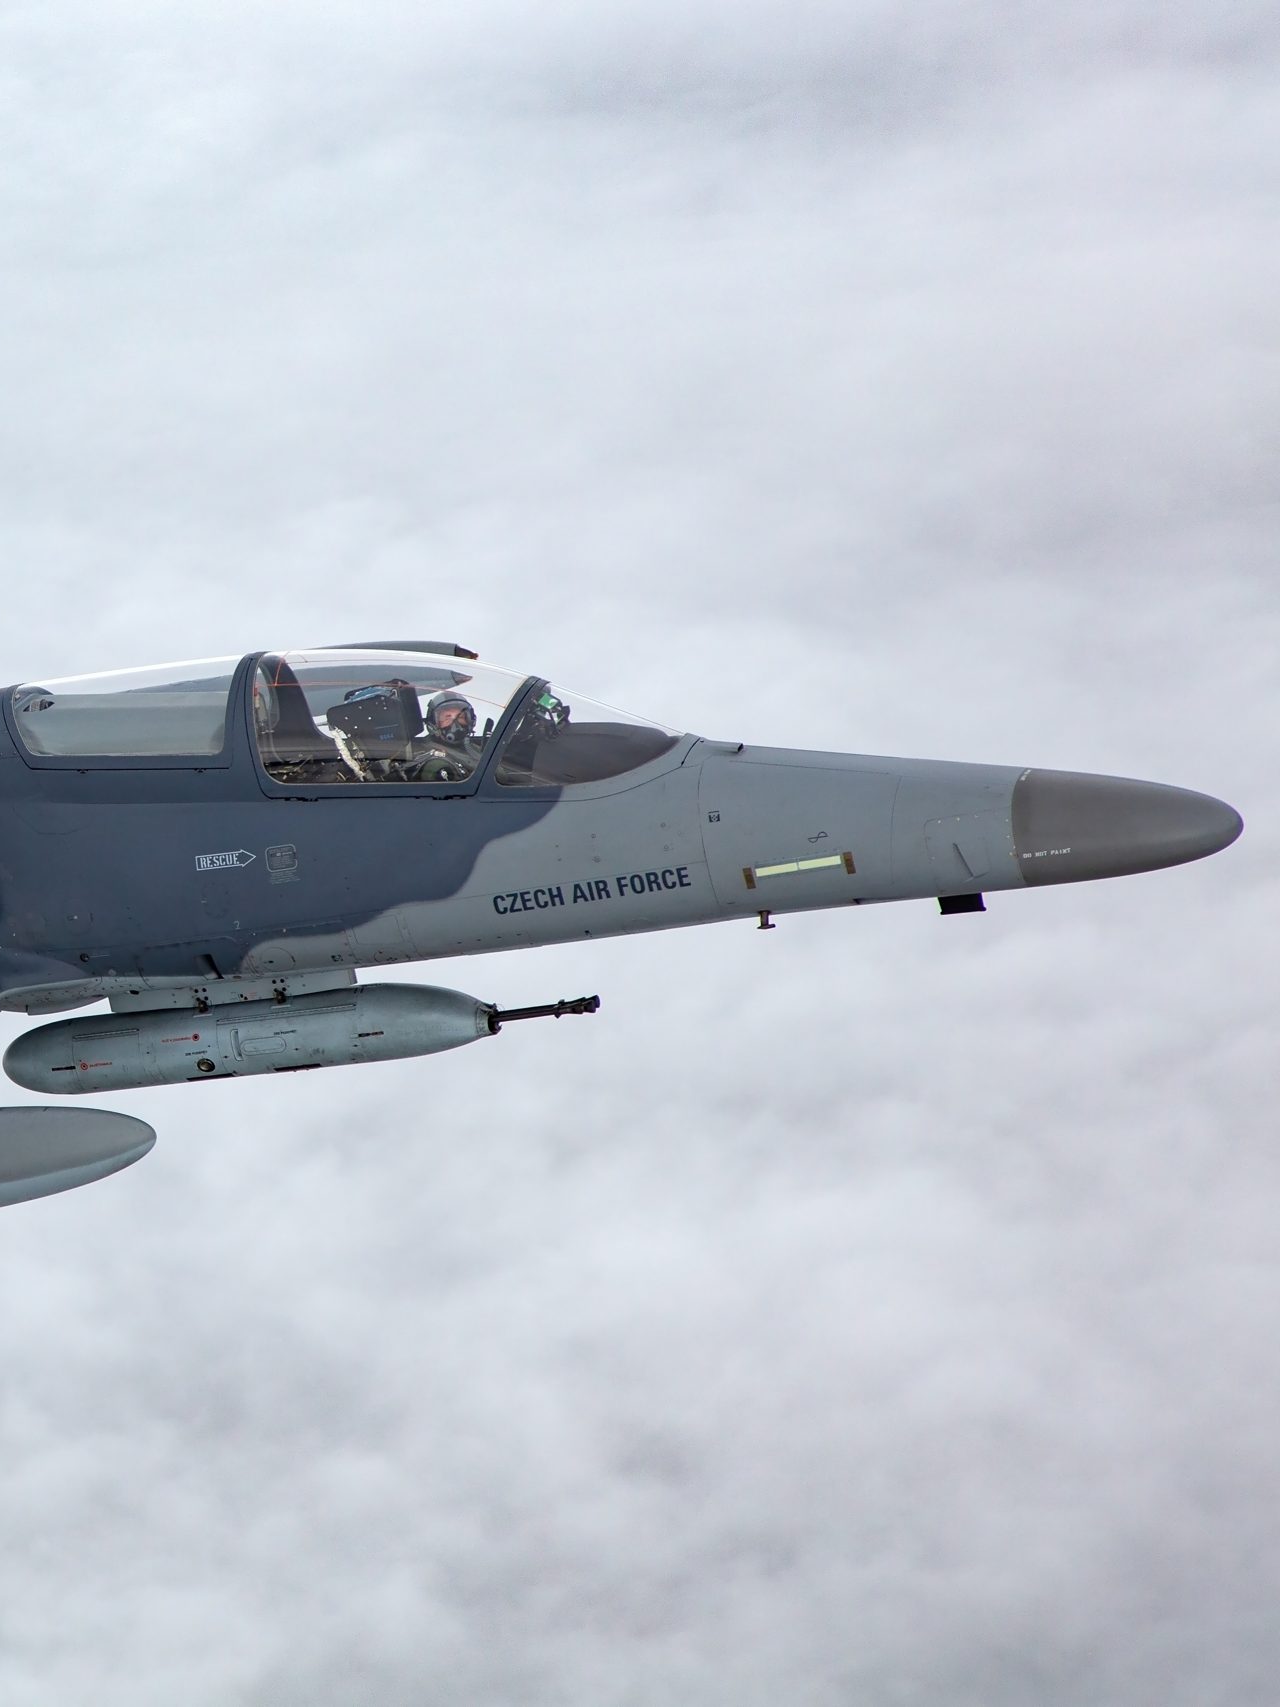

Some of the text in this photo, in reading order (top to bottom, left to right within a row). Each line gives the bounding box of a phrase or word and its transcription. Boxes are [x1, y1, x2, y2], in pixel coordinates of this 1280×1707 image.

[1050, 847, 1071, 856] PAINT
[200, 853, 240, 869] RESCUE
[492, 866, 692, 915] CZECH AIR FORCE
